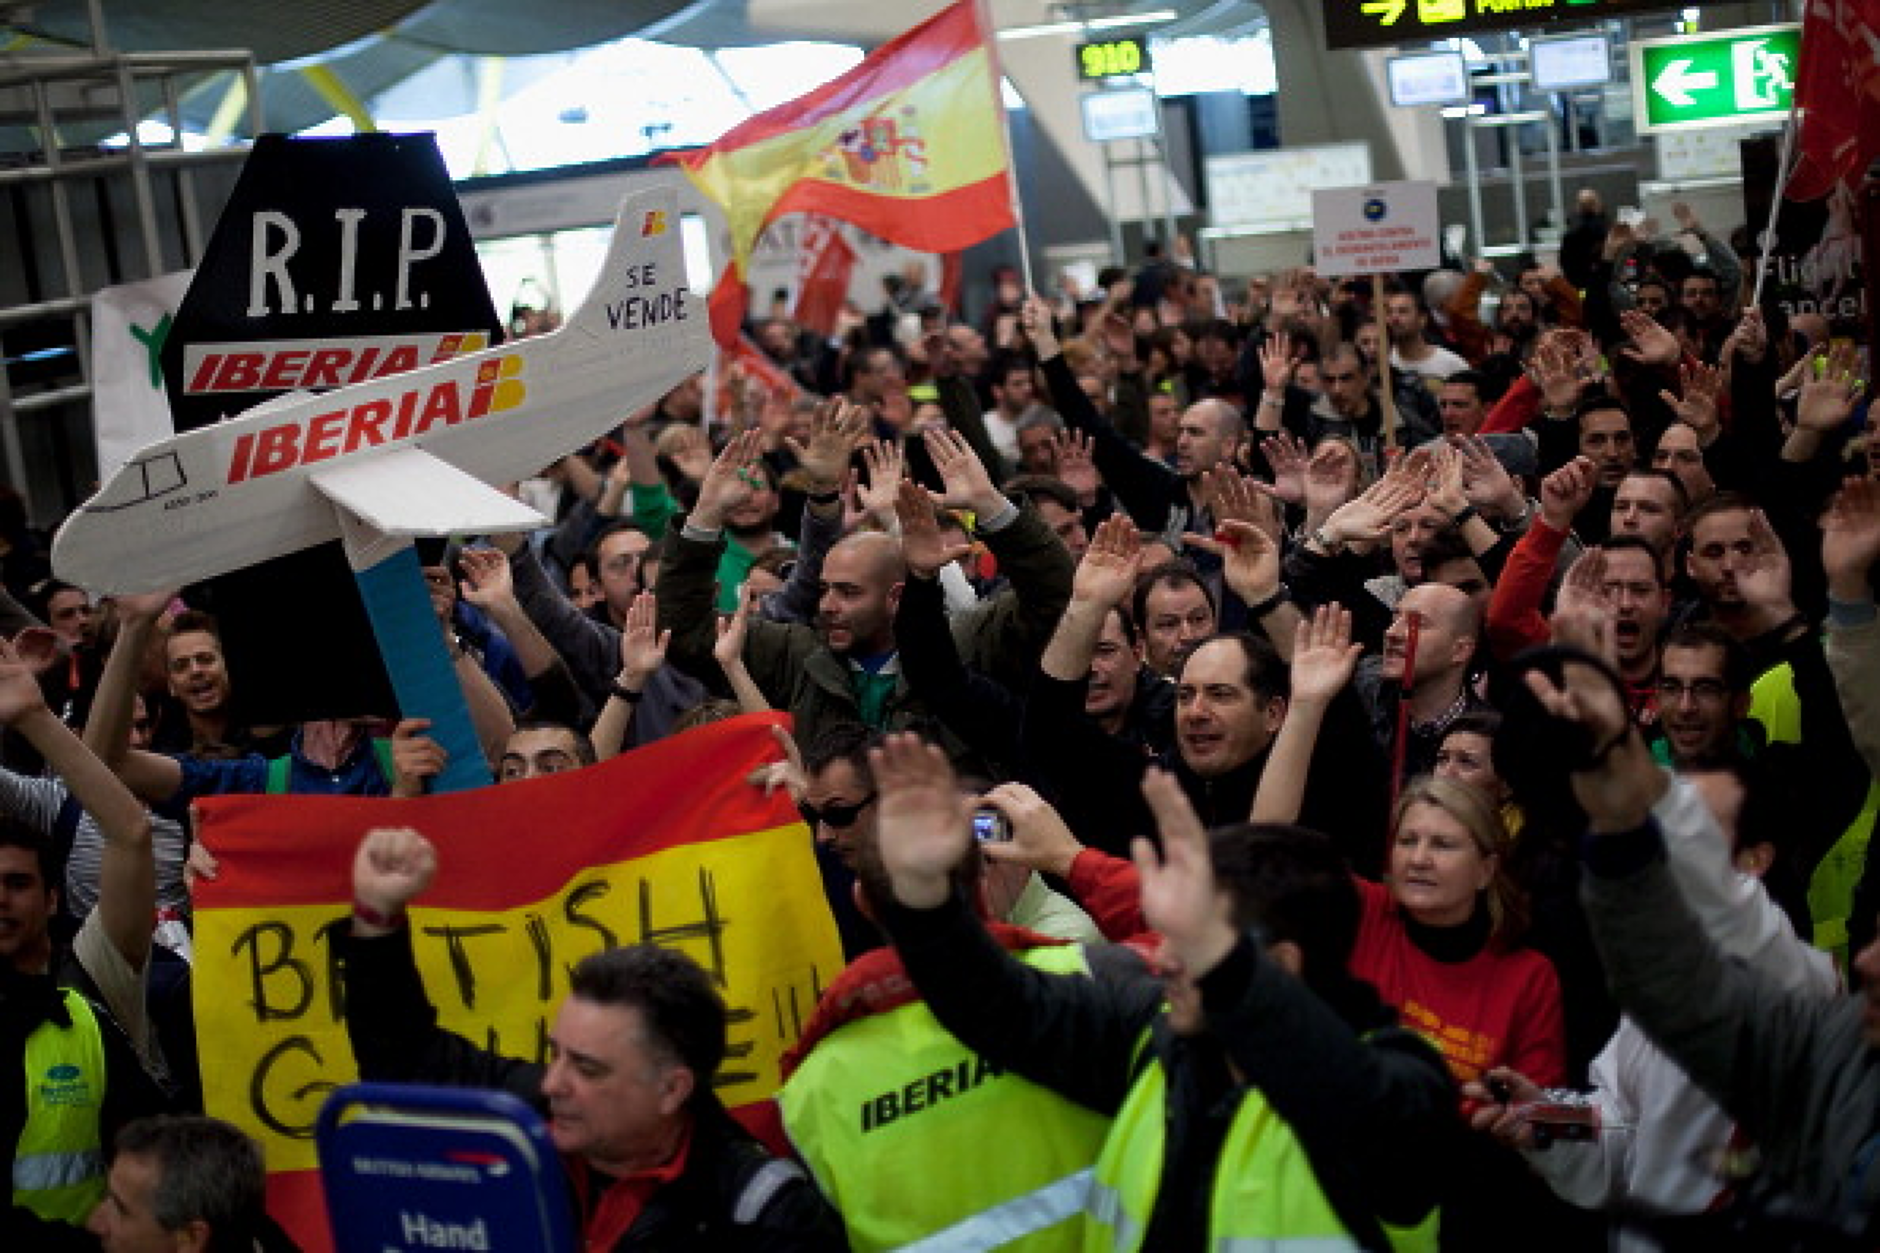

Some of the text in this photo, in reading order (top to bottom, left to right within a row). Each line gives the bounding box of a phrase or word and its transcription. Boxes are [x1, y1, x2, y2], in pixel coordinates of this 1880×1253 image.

[247, 206, 448, 317] R.I.P.
[626, 262, 656, 288] SE
[605, 287, 688, 330] VENDE
[1778, 287, 1867, 318] ancel
[189, 344, 419, 391] IBERIA
[227, 380, 461, 485] IBERIA
[400, 1210, 489, 1251] Hand
